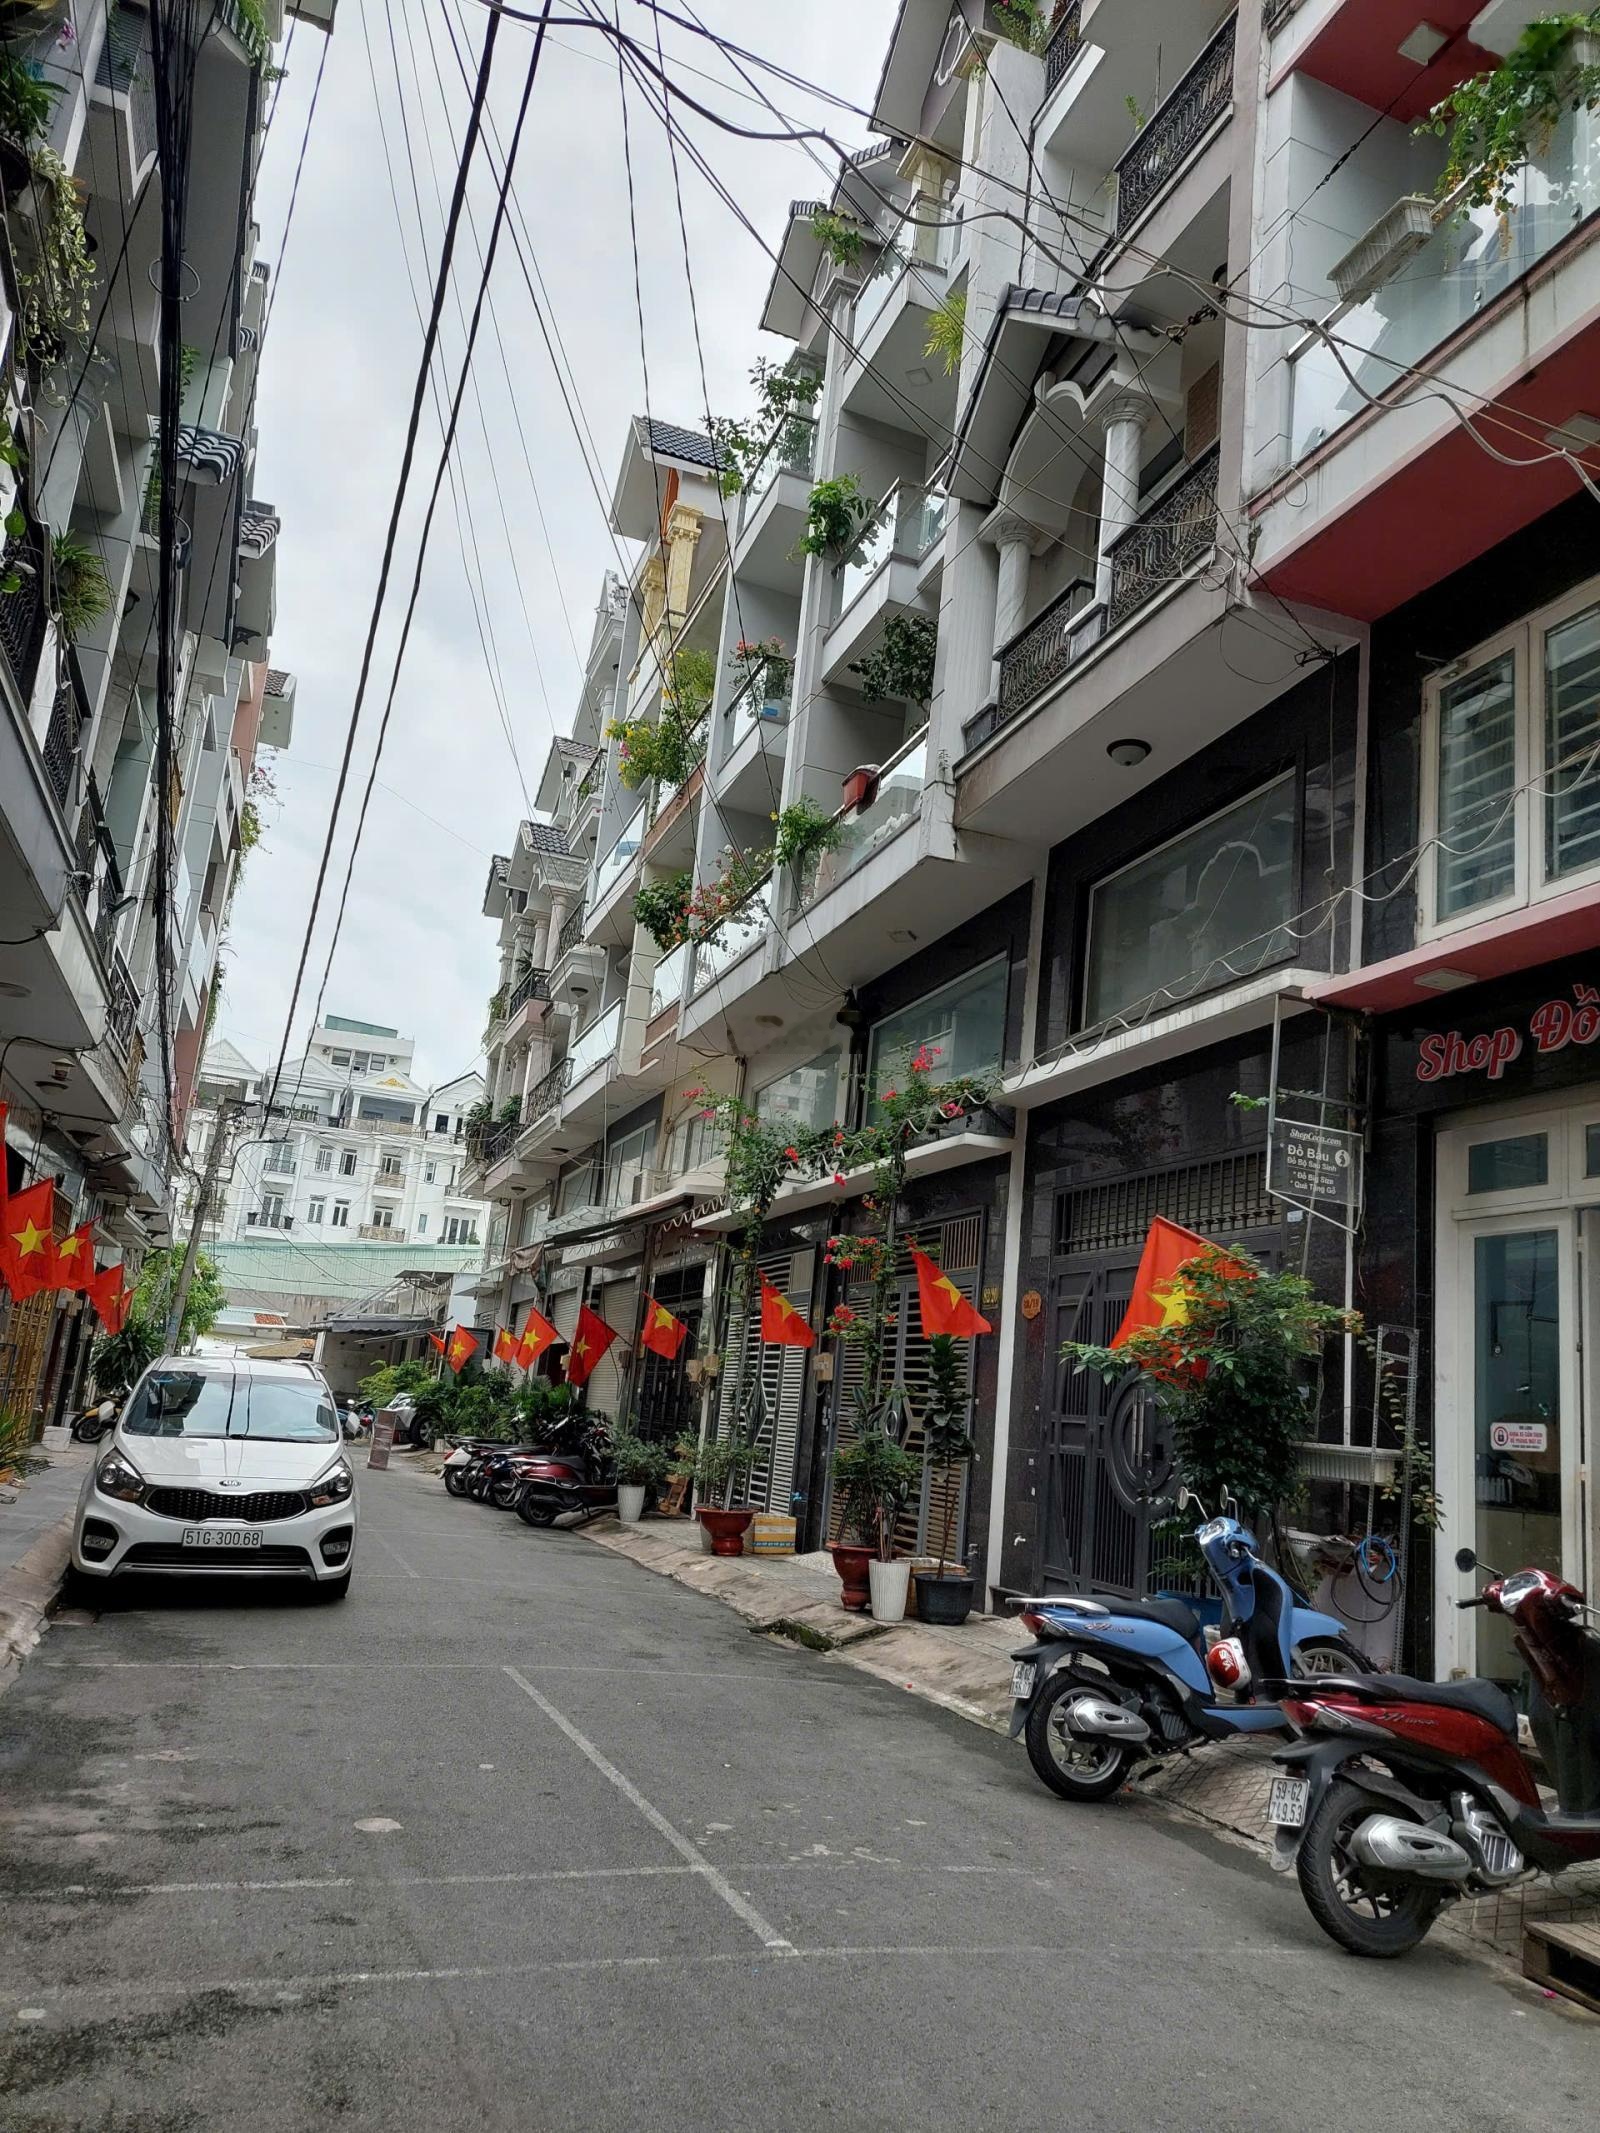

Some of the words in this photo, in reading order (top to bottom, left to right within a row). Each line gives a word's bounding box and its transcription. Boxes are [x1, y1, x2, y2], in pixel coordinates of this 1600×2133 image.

[1416, 1026, 1520, 1082] Shop
[185, 1531, 260, 1546] 51G-300.68
[1275, 1780, 1303, 1802] 59-G2
